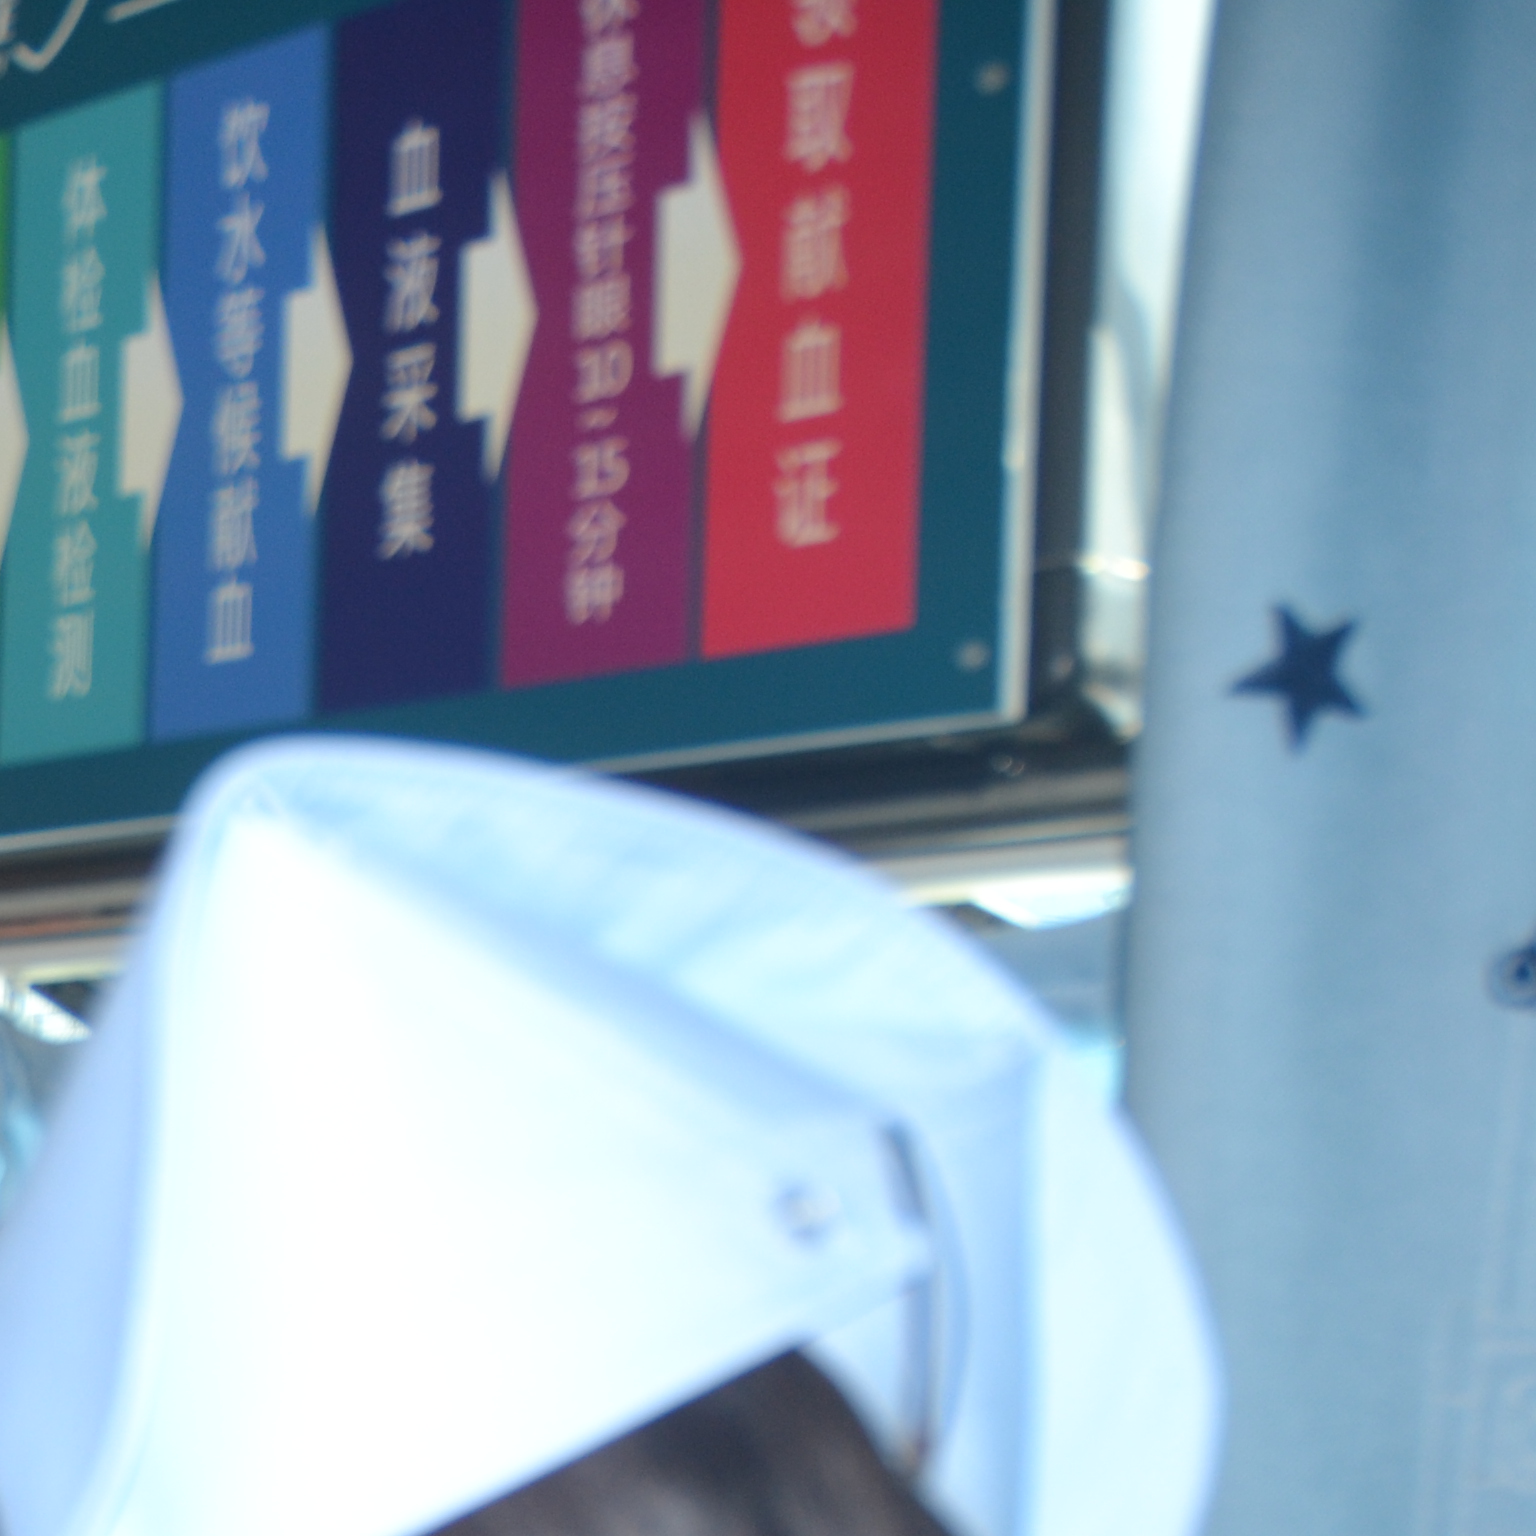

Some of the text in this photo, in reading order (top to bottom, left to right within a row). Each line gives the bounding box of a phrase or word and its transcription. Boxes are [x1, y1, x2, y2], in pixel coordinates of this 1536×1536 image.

[203, 97, 270, 665] 饮水等候献血
[376, 118, 443, 560] 血液采集
